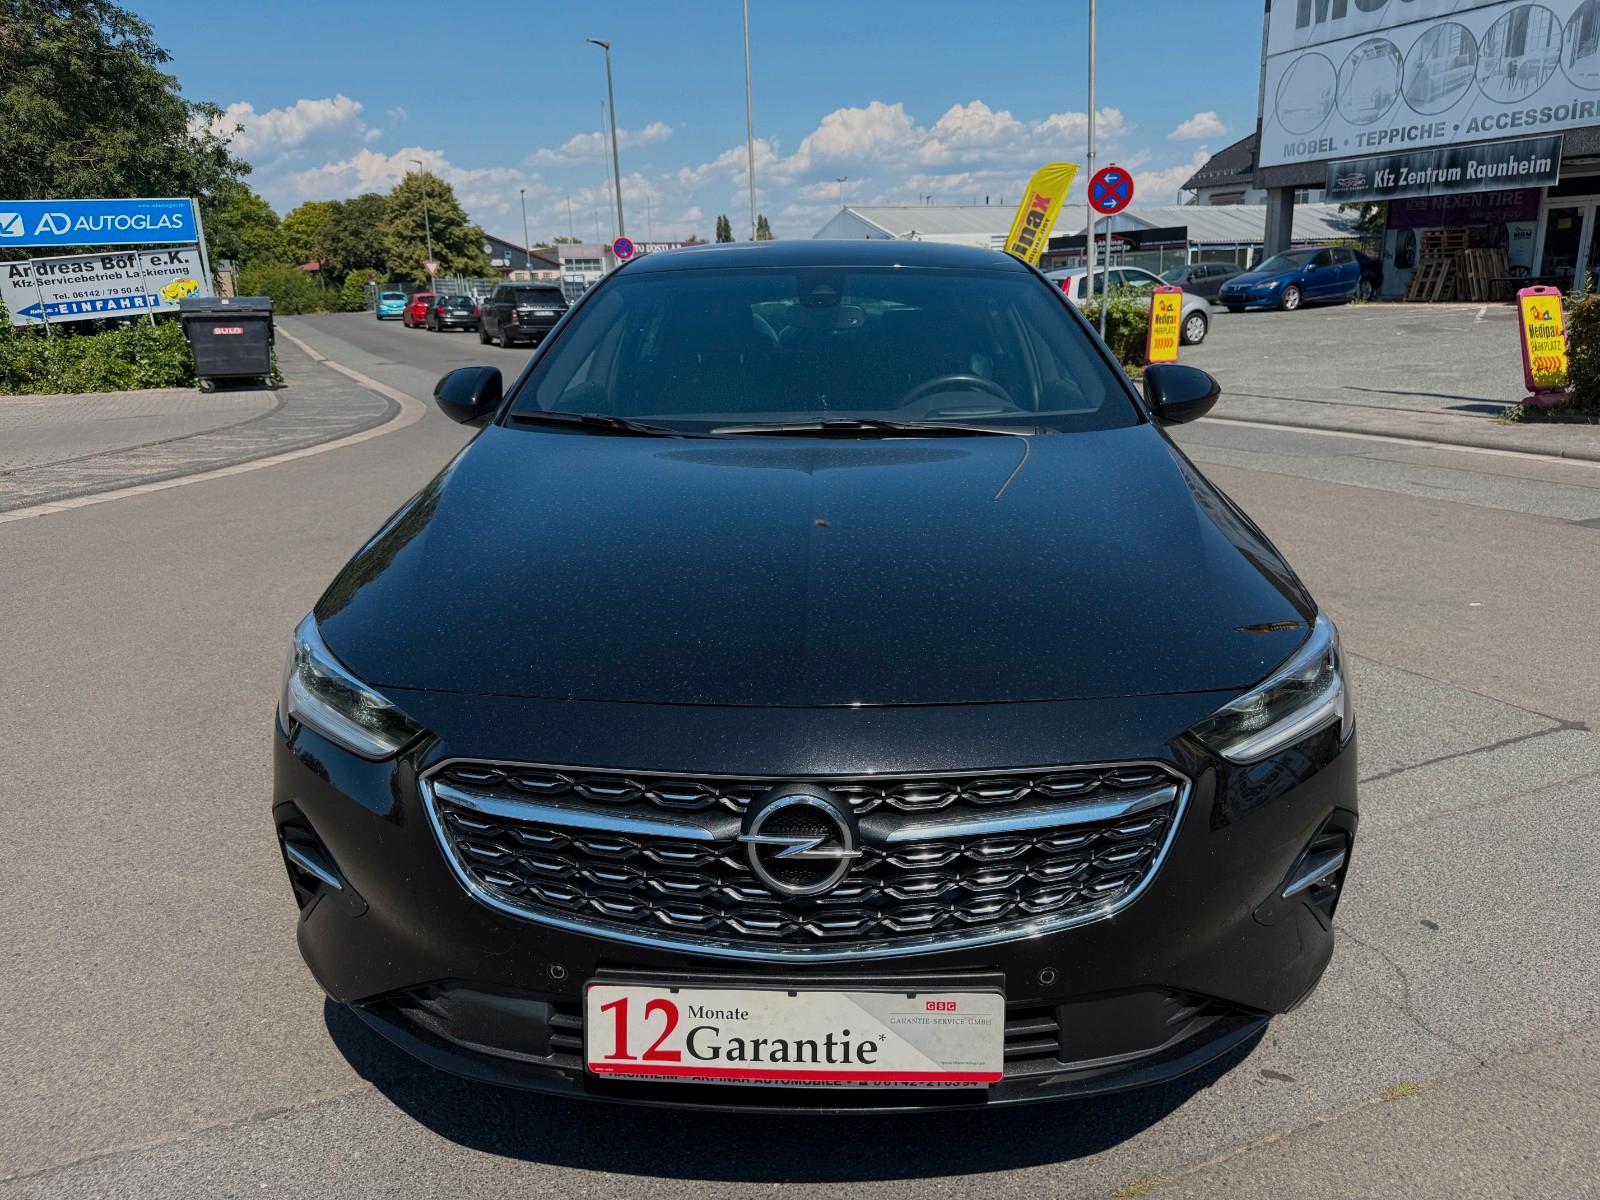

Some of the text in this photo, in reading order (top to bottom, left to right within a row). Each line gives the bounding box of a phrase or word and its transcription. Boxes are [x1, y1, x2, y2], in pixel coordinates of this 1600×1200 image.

[1283, 137, 1337, 158] MÖBEL
[1355, 121, 1446, 148] TEPPICHE
[1374, 154, 1552, 189] Kfz Zentrum Raunheim
[1431, 193, 1484, 209] NEXEN
[1487, 190, 1525, 207] TIRE
[34, 212, 183, 236] AD AUTOGLAS
[8, 261, 95, 279] Andreas
[150, 251, 190, 266] e.K.
[12, 262, 190, 288] Kfz-Servicebetrieb Lackierung
[53, 292, 70, 301] Tel.
[72, 289, 100, 299] 06142
[107, 288, 119, 296] 79
[121, 286, 132, 295] 50
[134, 285, 145, 294] 43
[59, 295, 157, 314] EINFAHRT
[1528, 323, 1559, 340] Medipax
[1530, 340, 1562, 352] PARKPLATZ
[926, 1001, 956, 1011] GSG
[600, 996, 749, 1062] 12 Monate
